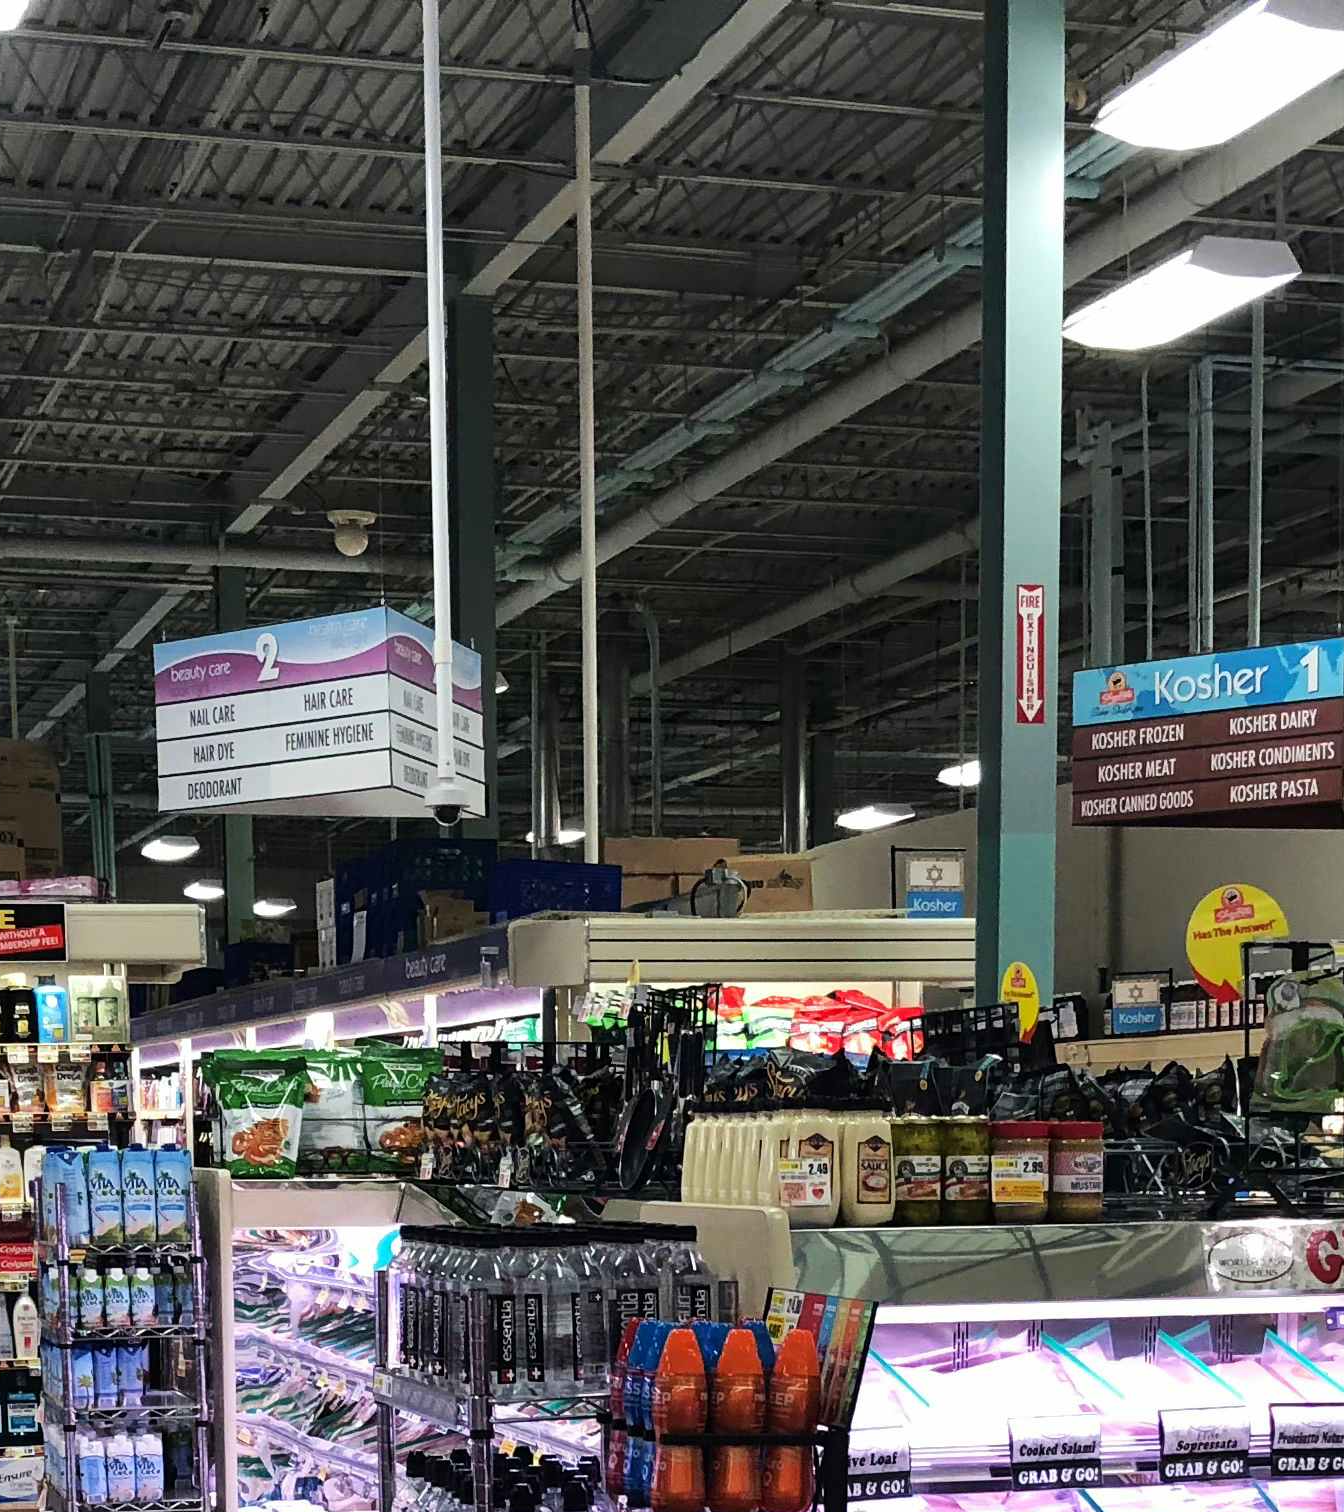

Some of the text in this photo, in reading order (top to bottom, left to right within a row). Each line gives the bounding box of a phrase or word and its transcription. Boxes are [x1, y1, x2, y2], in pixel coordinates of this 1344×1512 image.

[1021, 596, 1040, 608] FIRE
[256, 633, 279, 682] 2
[171, 662, 230, 682] beauty care
[1299, 648, 1319, 692] 1
[1155, 662, 1269, 705] Kosher
[304, 688, 353, 711] HAIR CARE
[189, 704, 235, 727] NAIL CARE
[1230, 708, 1317, 735] KOSHER DAIRY
[285, 729, 330, 751] FEMININE
[333, 722, 374, 745] HYGIENE
[1091, 724, 1184, 751] KOSHER FROZEN
[194, 742, 234, 763] HAIR DYE
[1211, 741, 1334, 771] KOSHER CONDIMENTS
[1098, 758, 1176, 782] KOSHER MEAT
[188, 778, 242, 801] DEODORANT
[1230, 778, 1318, 803] KOSHER PASTA
[1081, 790, 1193, 817] KOSHER CANNED GOODS
[912, 898, 958, 916] Kosher
[41, 936, 59, 946] FEE!
[1193, 922, 1273, 940] Has The Answer!
[405, 953, 447, 980] beauty care
[1119, 1013, 1156, 1025] Kosher
[809, 1163, 828, 1175] 2.49
[1023, 1161, 1044, 1174] 2.99
[502, 1300, 513, 1362] essentia
[528, 1297, 537, 1360] essentia
[1019, 1441, 1096, 1457] Cooked Salami
[1175, 1437, 1238, 1452] Sopressata
[1018, 1467, 1098, 1485] GRAB & GO!
